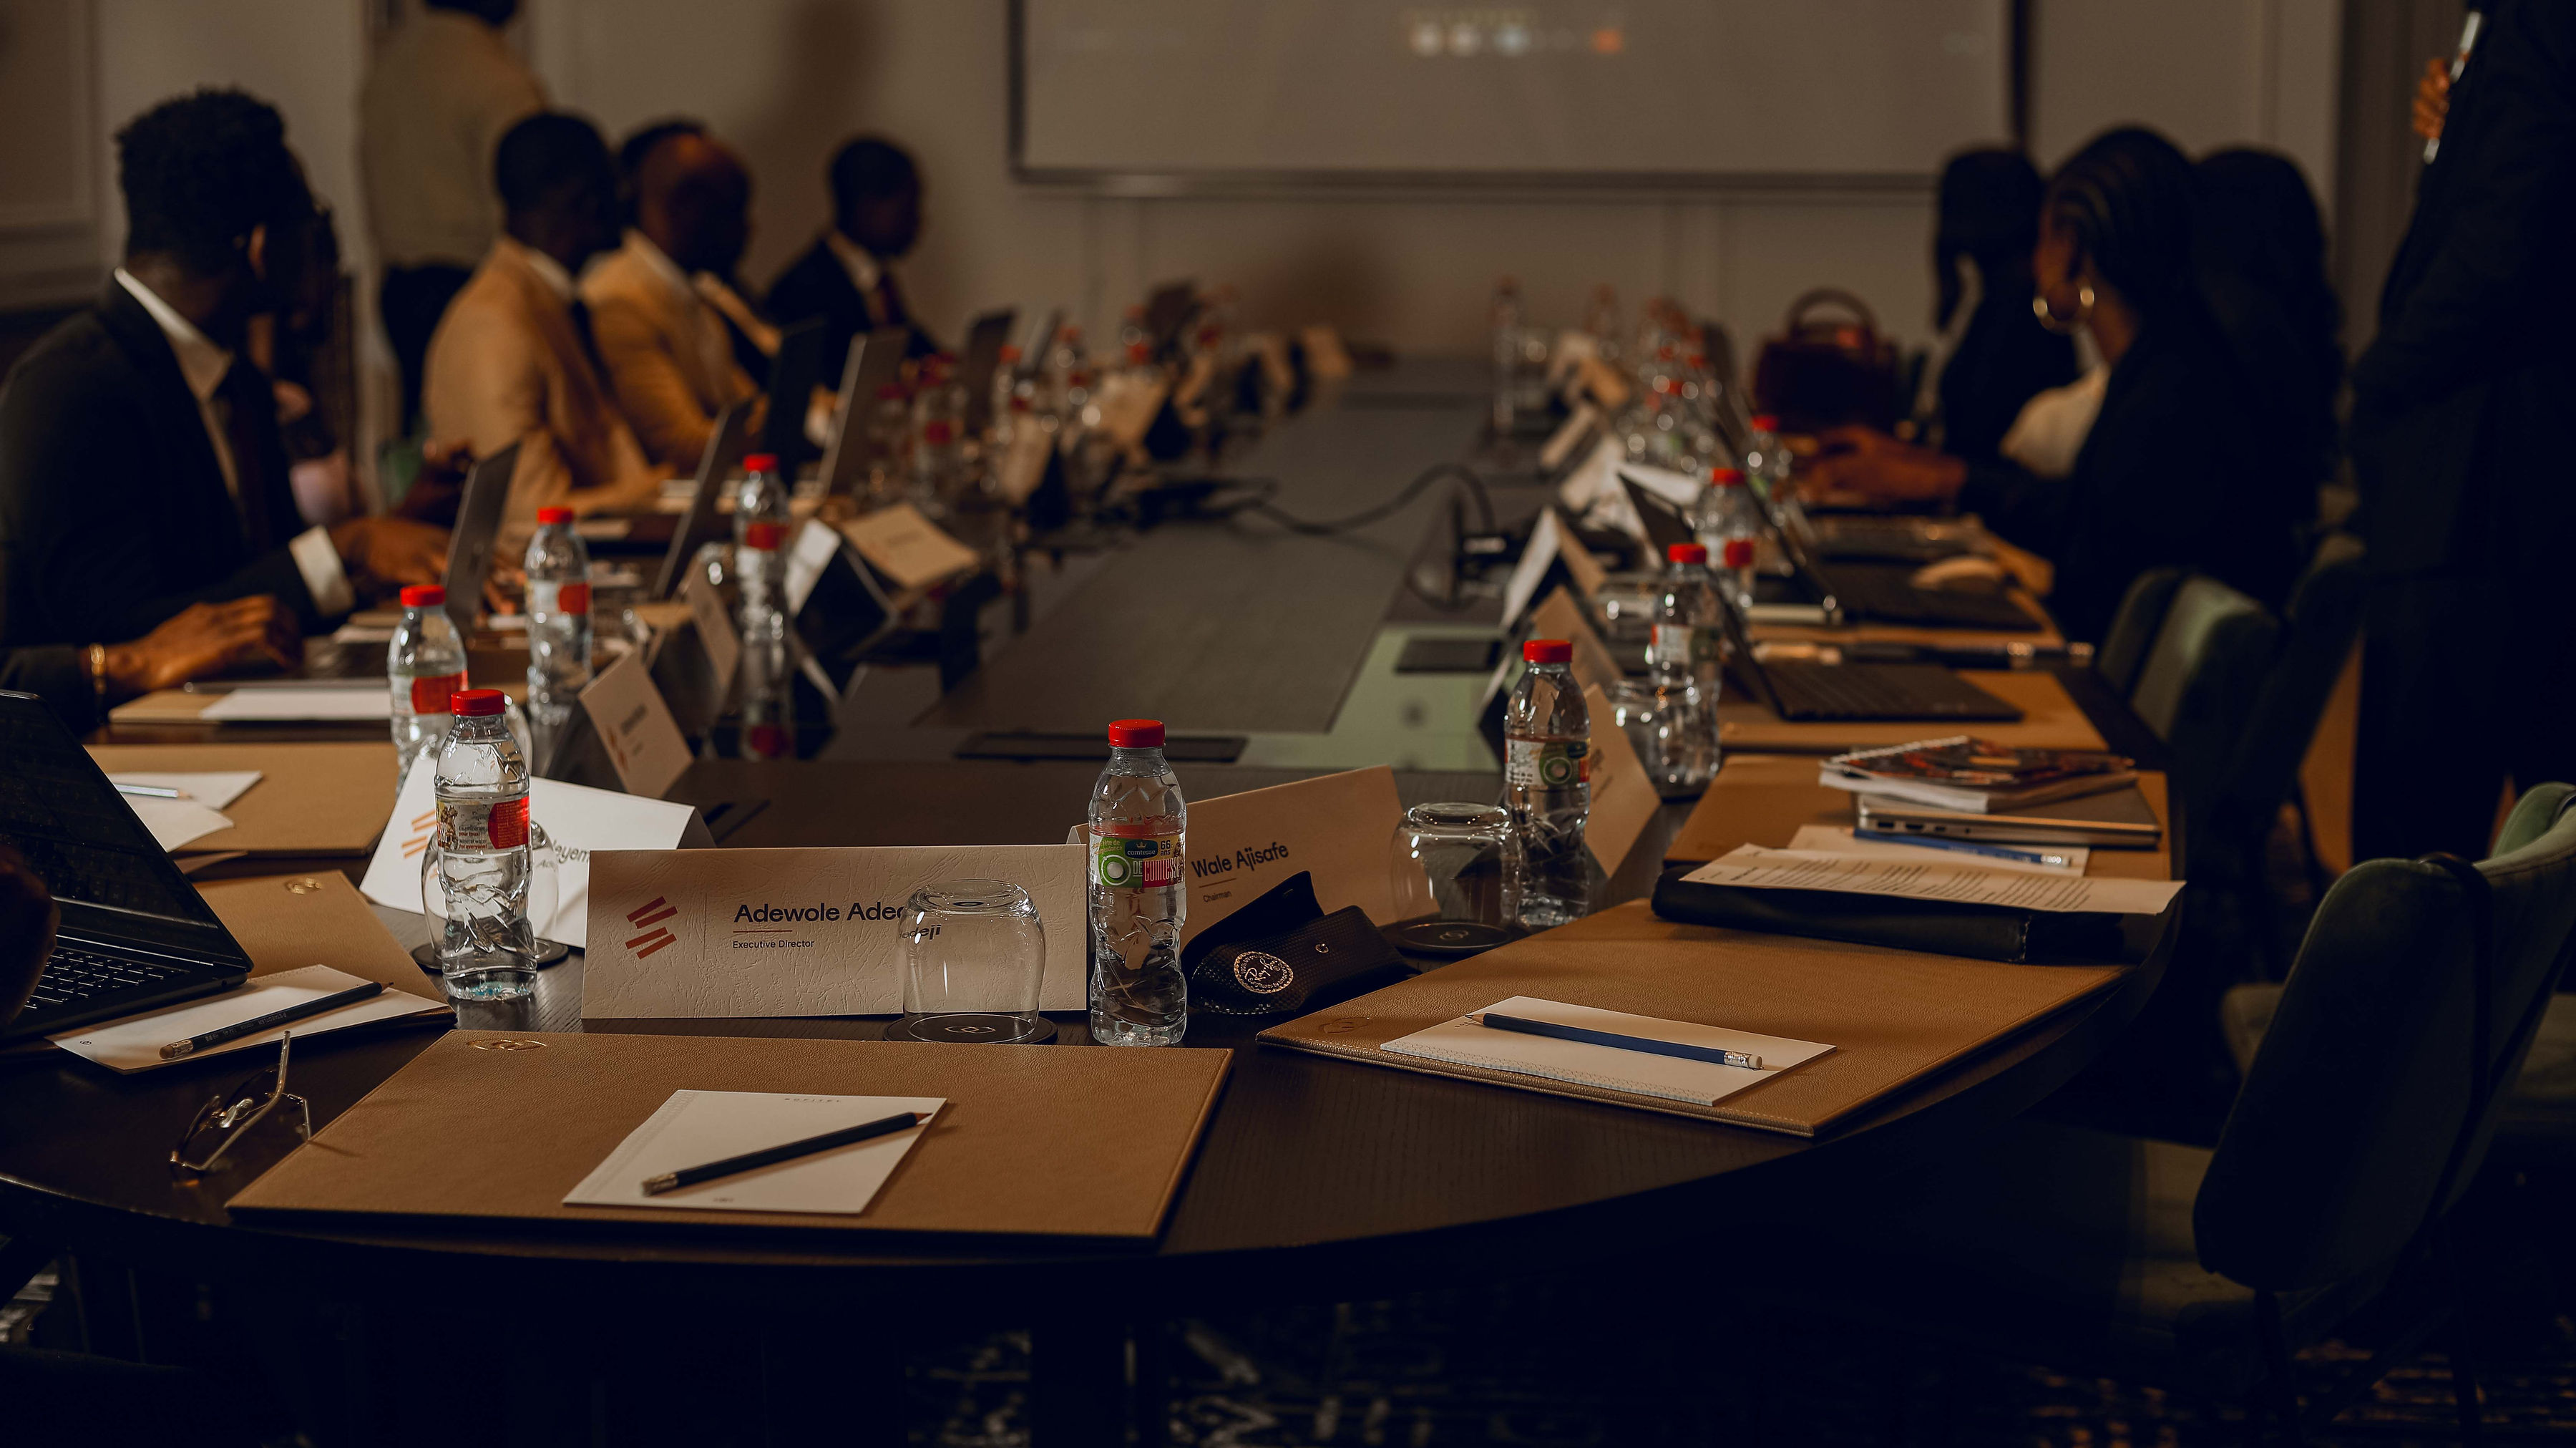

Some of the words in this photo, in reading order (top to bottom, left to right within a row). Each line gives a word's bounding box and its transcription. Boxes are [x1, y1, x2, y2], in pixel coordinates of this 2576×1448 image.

[1161, 840, 1171, 850] 66
[1191, 855, 1232, 878] Wale
[1236, 842, 1289, 871] Ajisafe
[1204, 890, 1232, 903] Chairman
[733, 903, 840, 923] Adewole
[779, 939, 814, 948] Director
